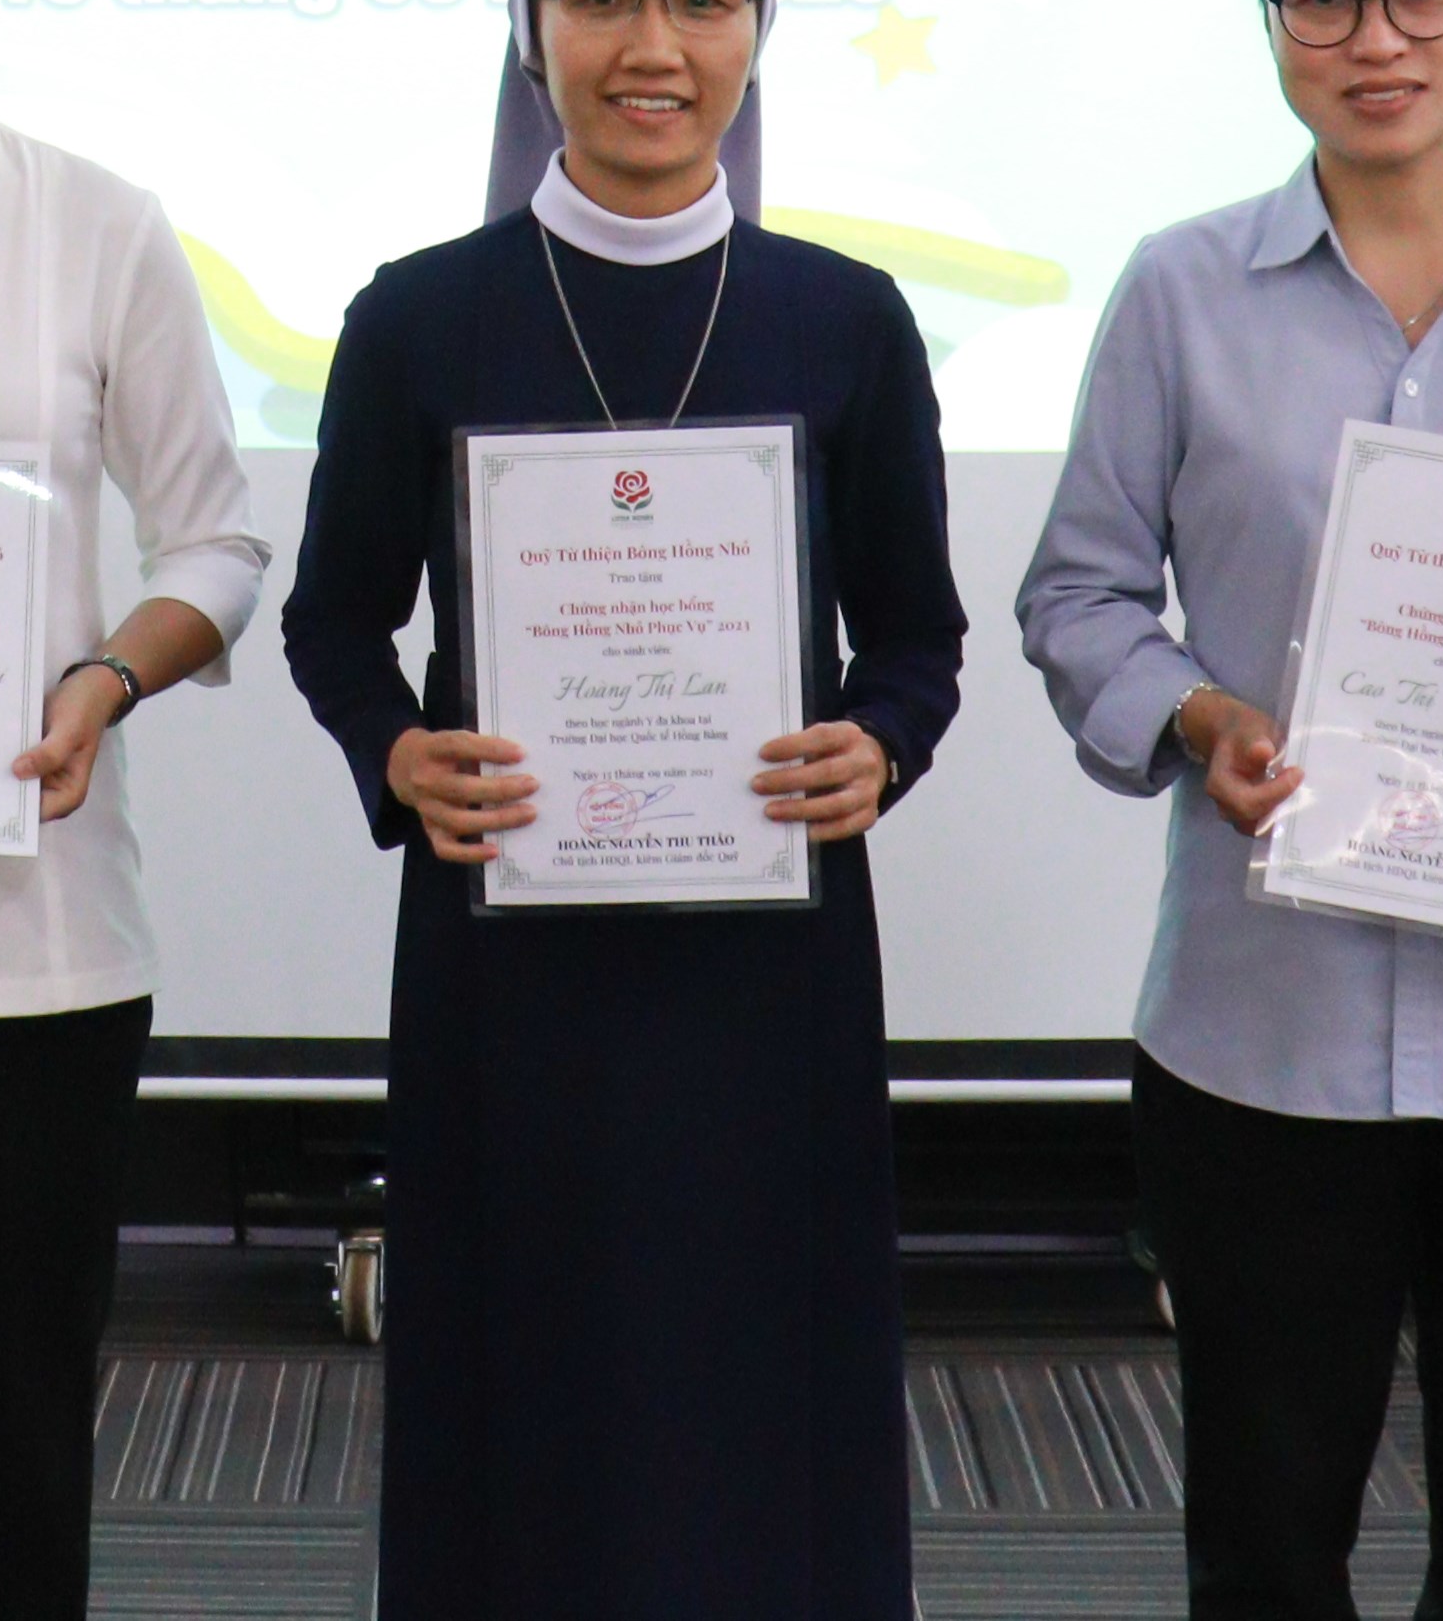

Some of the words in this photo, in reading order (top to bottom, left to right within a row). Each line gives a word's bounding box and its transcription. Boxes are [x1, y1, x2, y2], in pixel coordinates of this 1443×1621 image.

[519, 547, 550, 567] Quỹ
[556, 546, 578, 562] Từ
[581, 545, 623, 564] thiện
[627, 544, 667, 561] Bông
[671, 541, 715, 559] Hồng
[719, 539, 751, 556] Nhỏ
[559, 601, 607, 617] Chứng
[610, 599, 647, 616] nhận
[649, 598, 675, 615] học
[678, 594, 715, 613] bổng
[573, 621, 611, 638] Hồng
[615, 619, 644, 636] Nhỏ
[647, 619, 683, 635] Phục
[717, 619, 751, 632] 2023
[553, 675, 632, 712] Hoàng
[636, 670, 676, 701] Thị
[681, 672, 728, 697] Lan
[1340, 670, 1385, 699] Cao
[557, 837, 607, 851] HOÀNG
[608, 831, 663, 849] NGUYỄN
[666, 835, 690, 848] THU
[697, 831, 735, 847] THẢO
